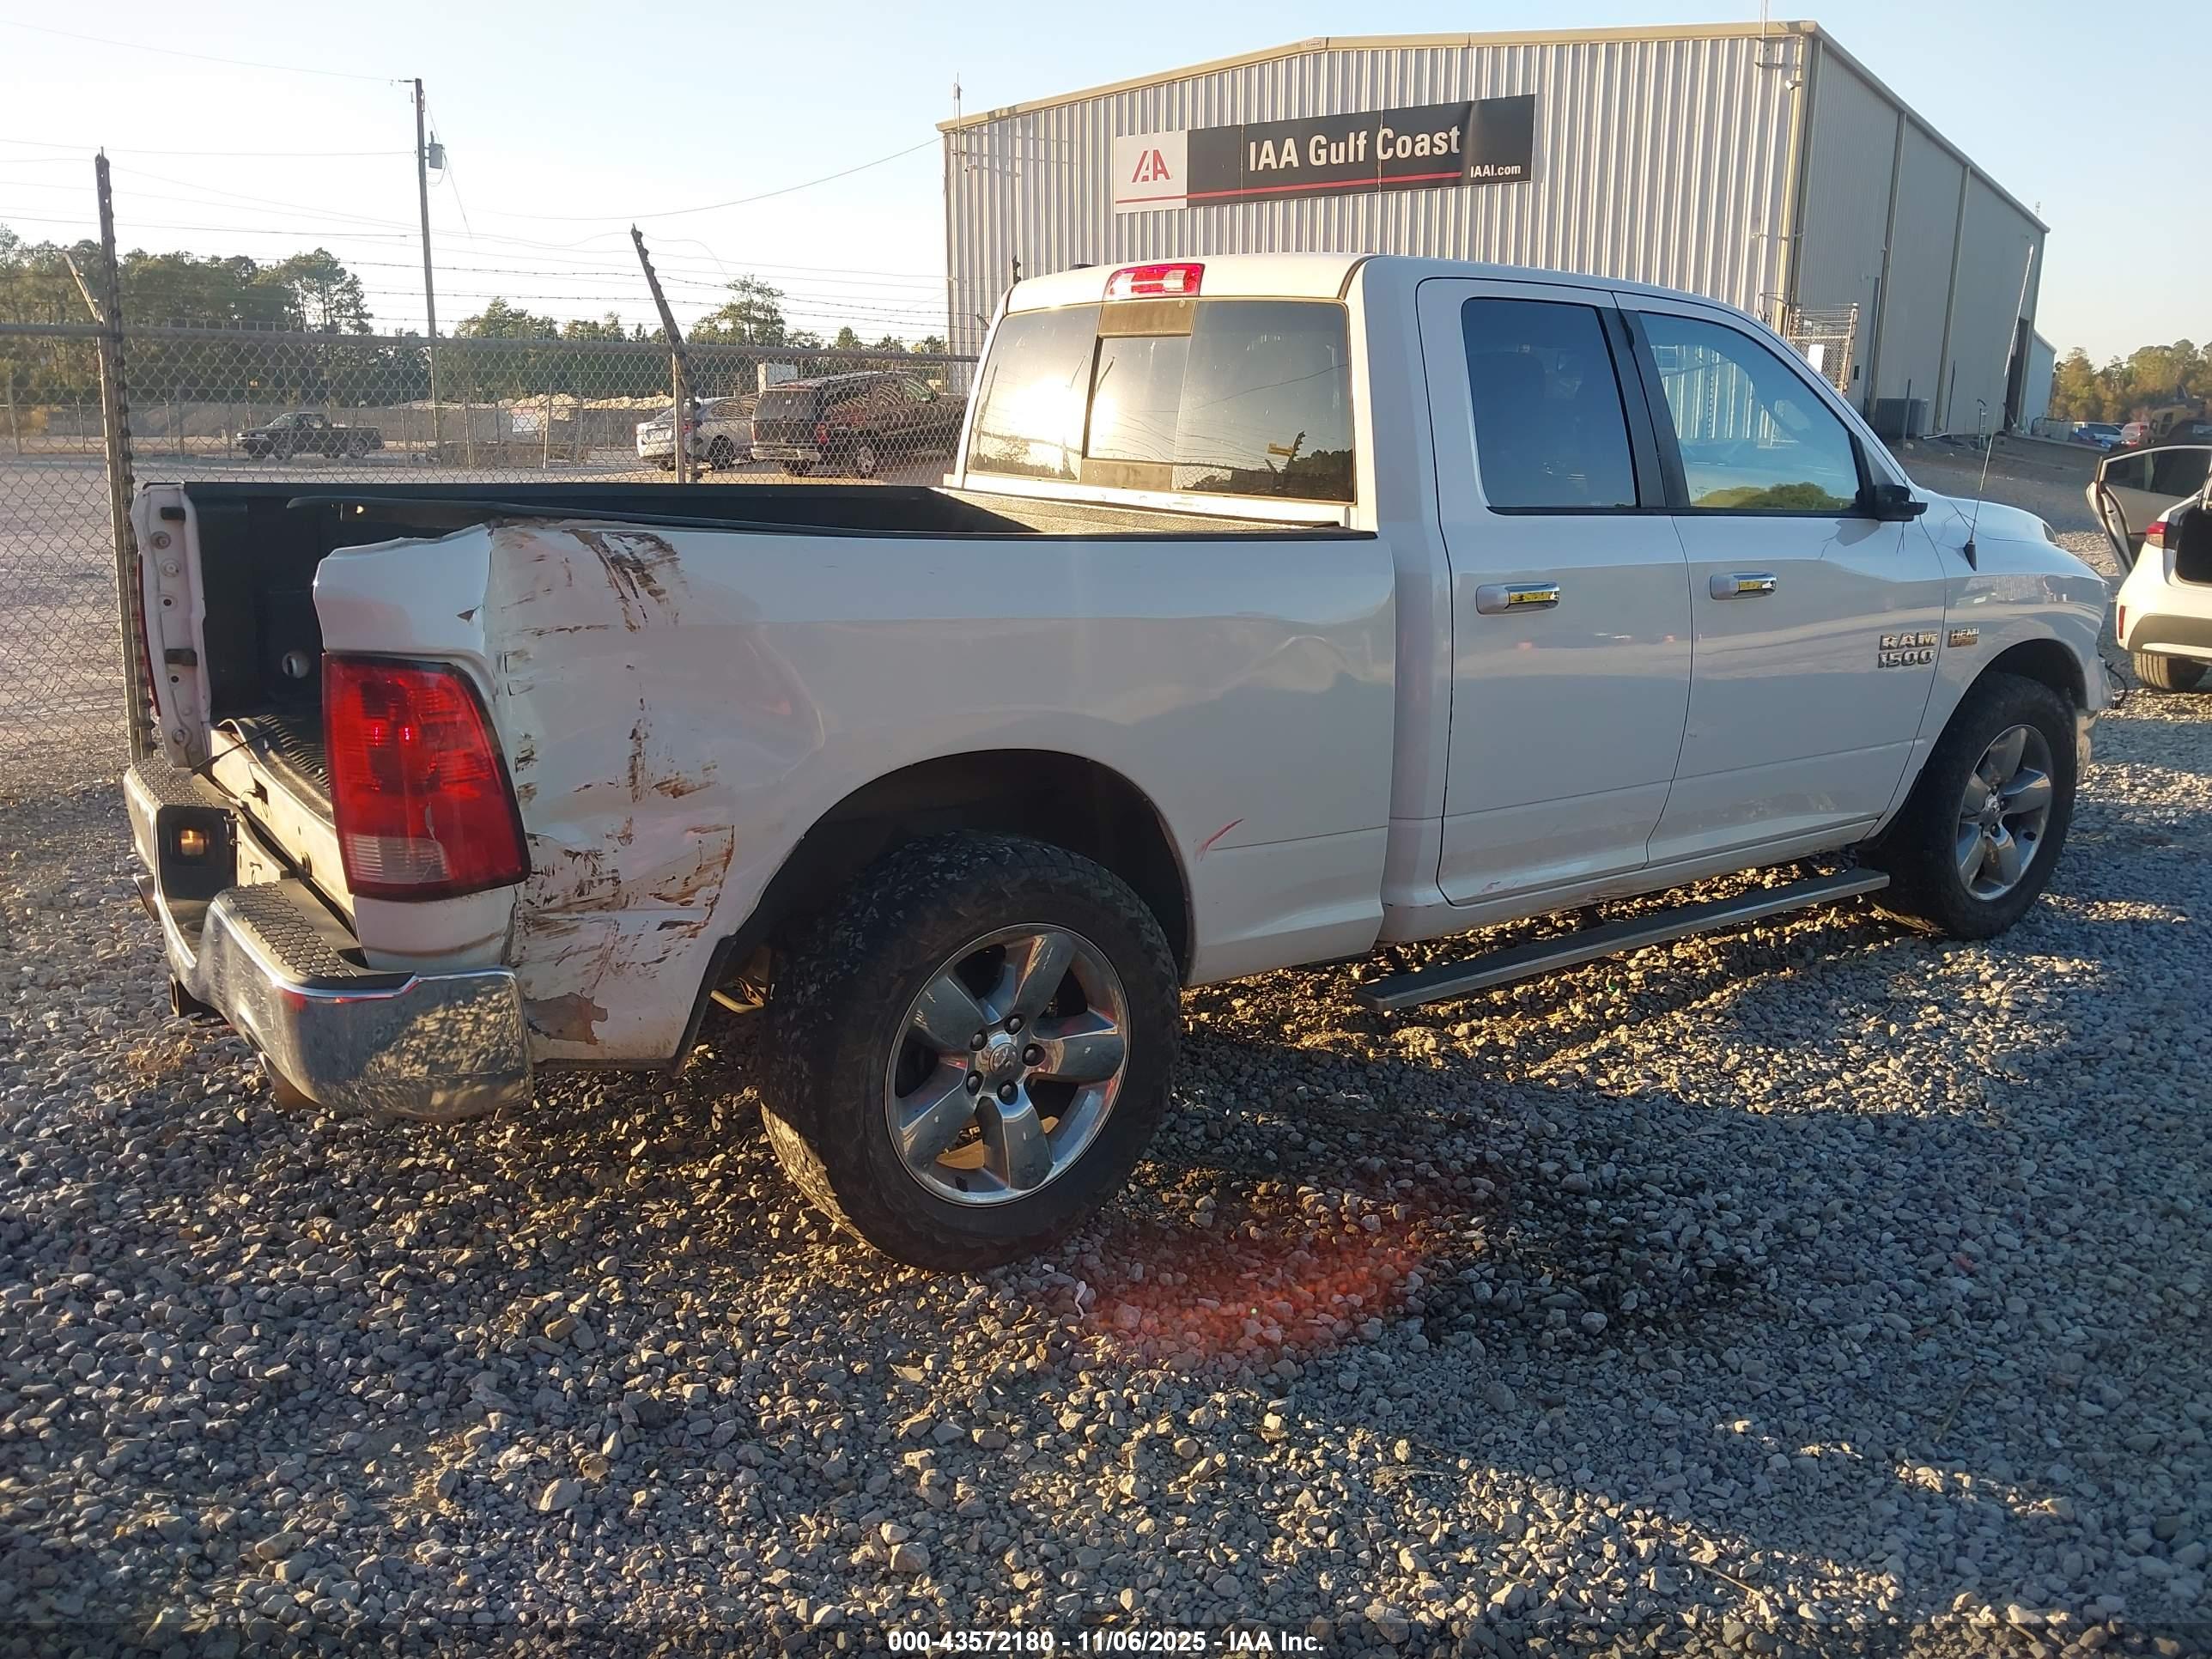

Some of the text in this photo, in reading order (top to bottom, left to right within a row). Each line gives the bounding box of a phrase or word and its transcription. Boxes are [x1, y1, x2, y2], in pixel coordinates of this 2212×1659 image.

[1249, 124, 1461, 172] IAA Gulf Coast
[1470, 164, 1521, 179] IAAI.com
[1880, 632, 1938, 650] RAM
[1878, 649, 1935, 668] 1500
